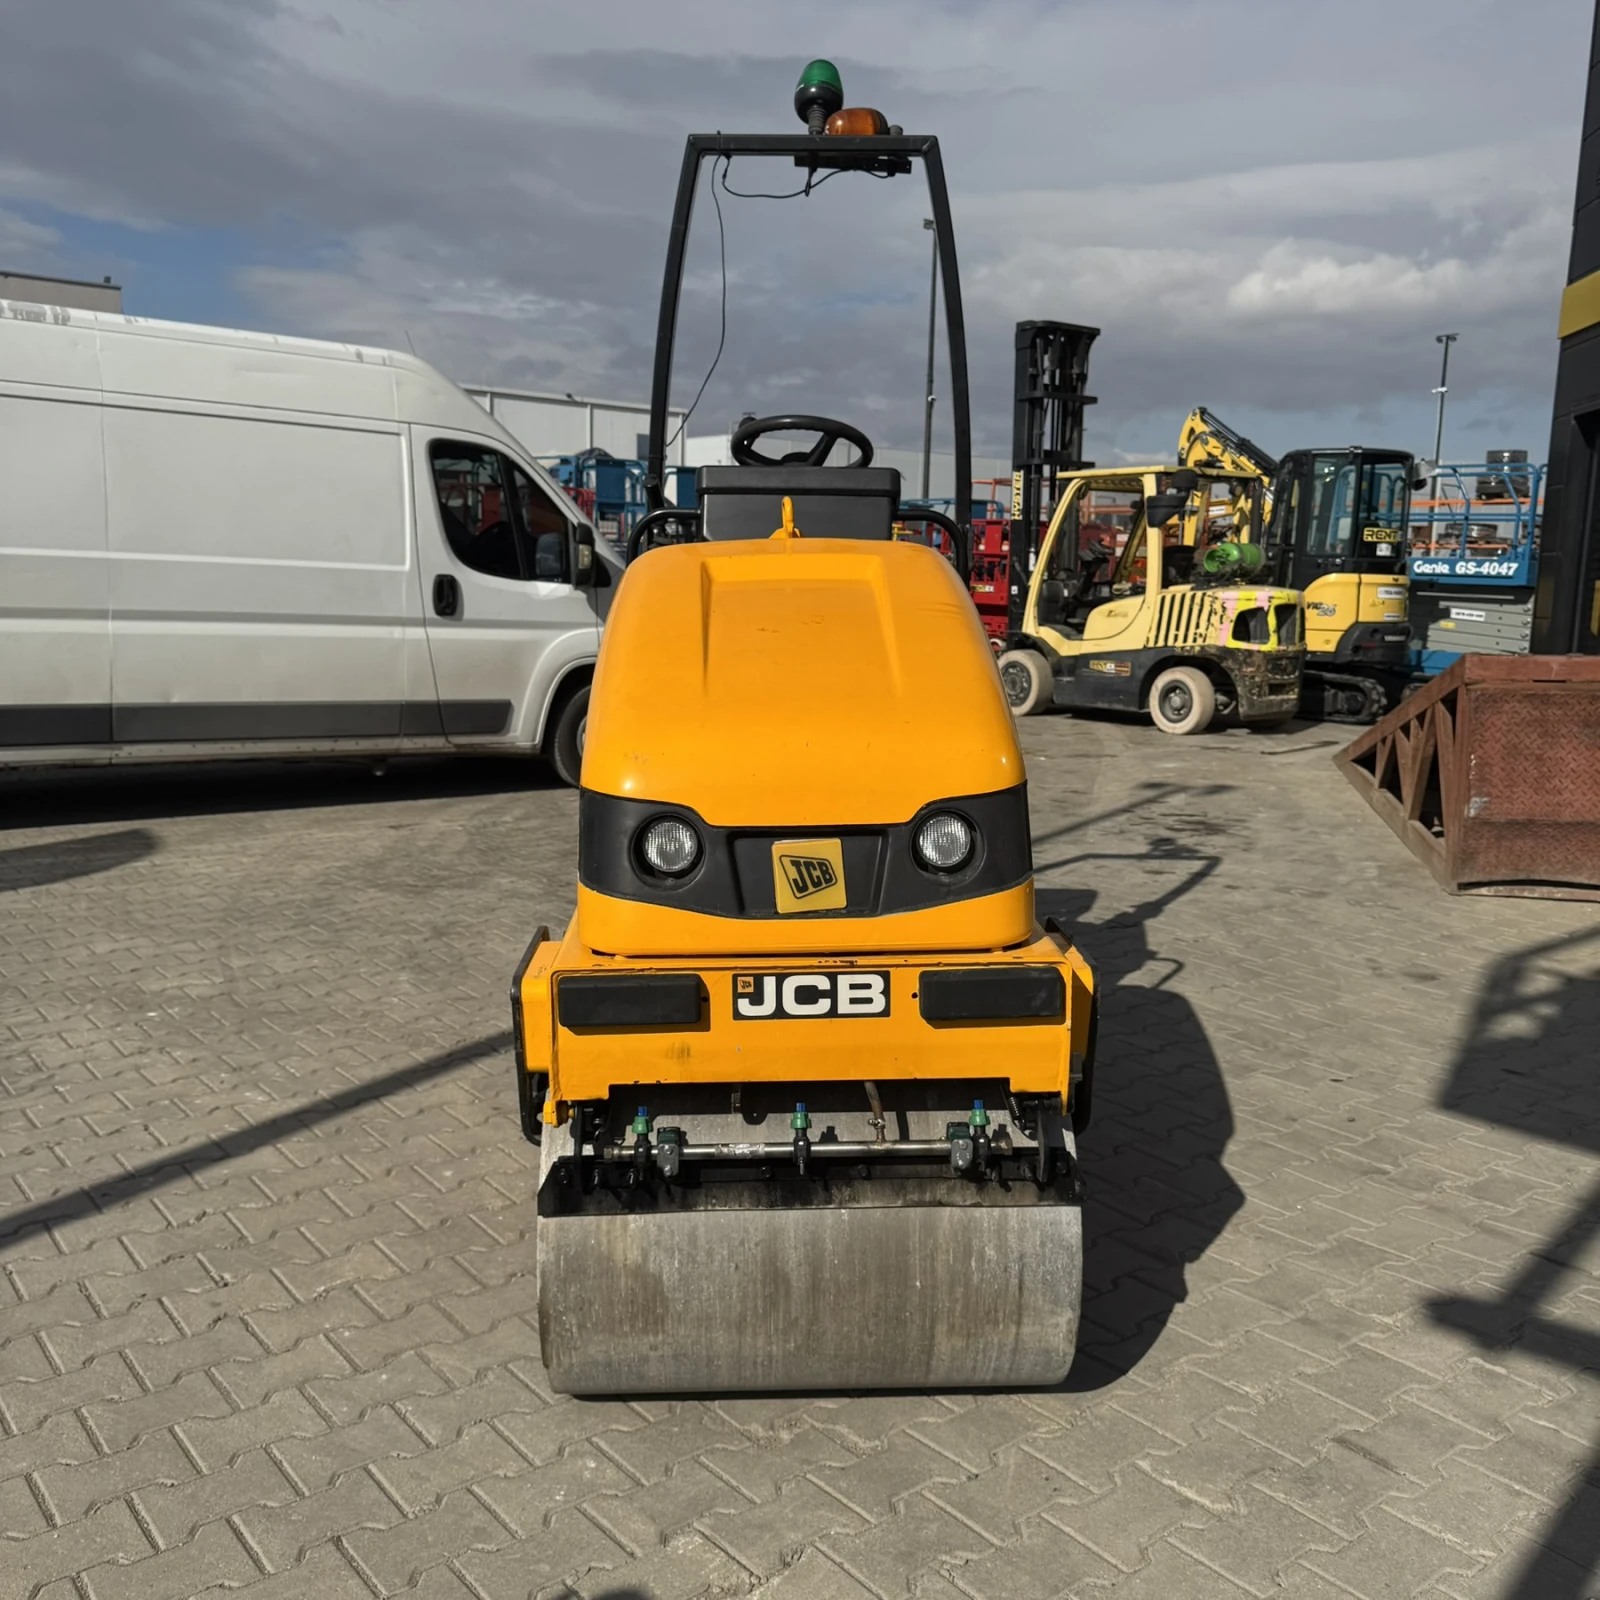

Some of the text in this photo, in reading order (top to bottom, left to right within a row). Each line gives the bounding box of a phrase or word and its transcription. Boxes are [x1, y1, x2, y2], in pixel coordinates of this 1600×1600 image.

[1012, 473, 1021, 519] HYSTER
[1364, 529, 1398, 541] RENT
[1413, 560, 1519, 576] Genie GS-4047
[790, 859, 833, 894] JCB
[738, 974, 886, 1016] JCB
[739, 979, 752, 989] JCB
